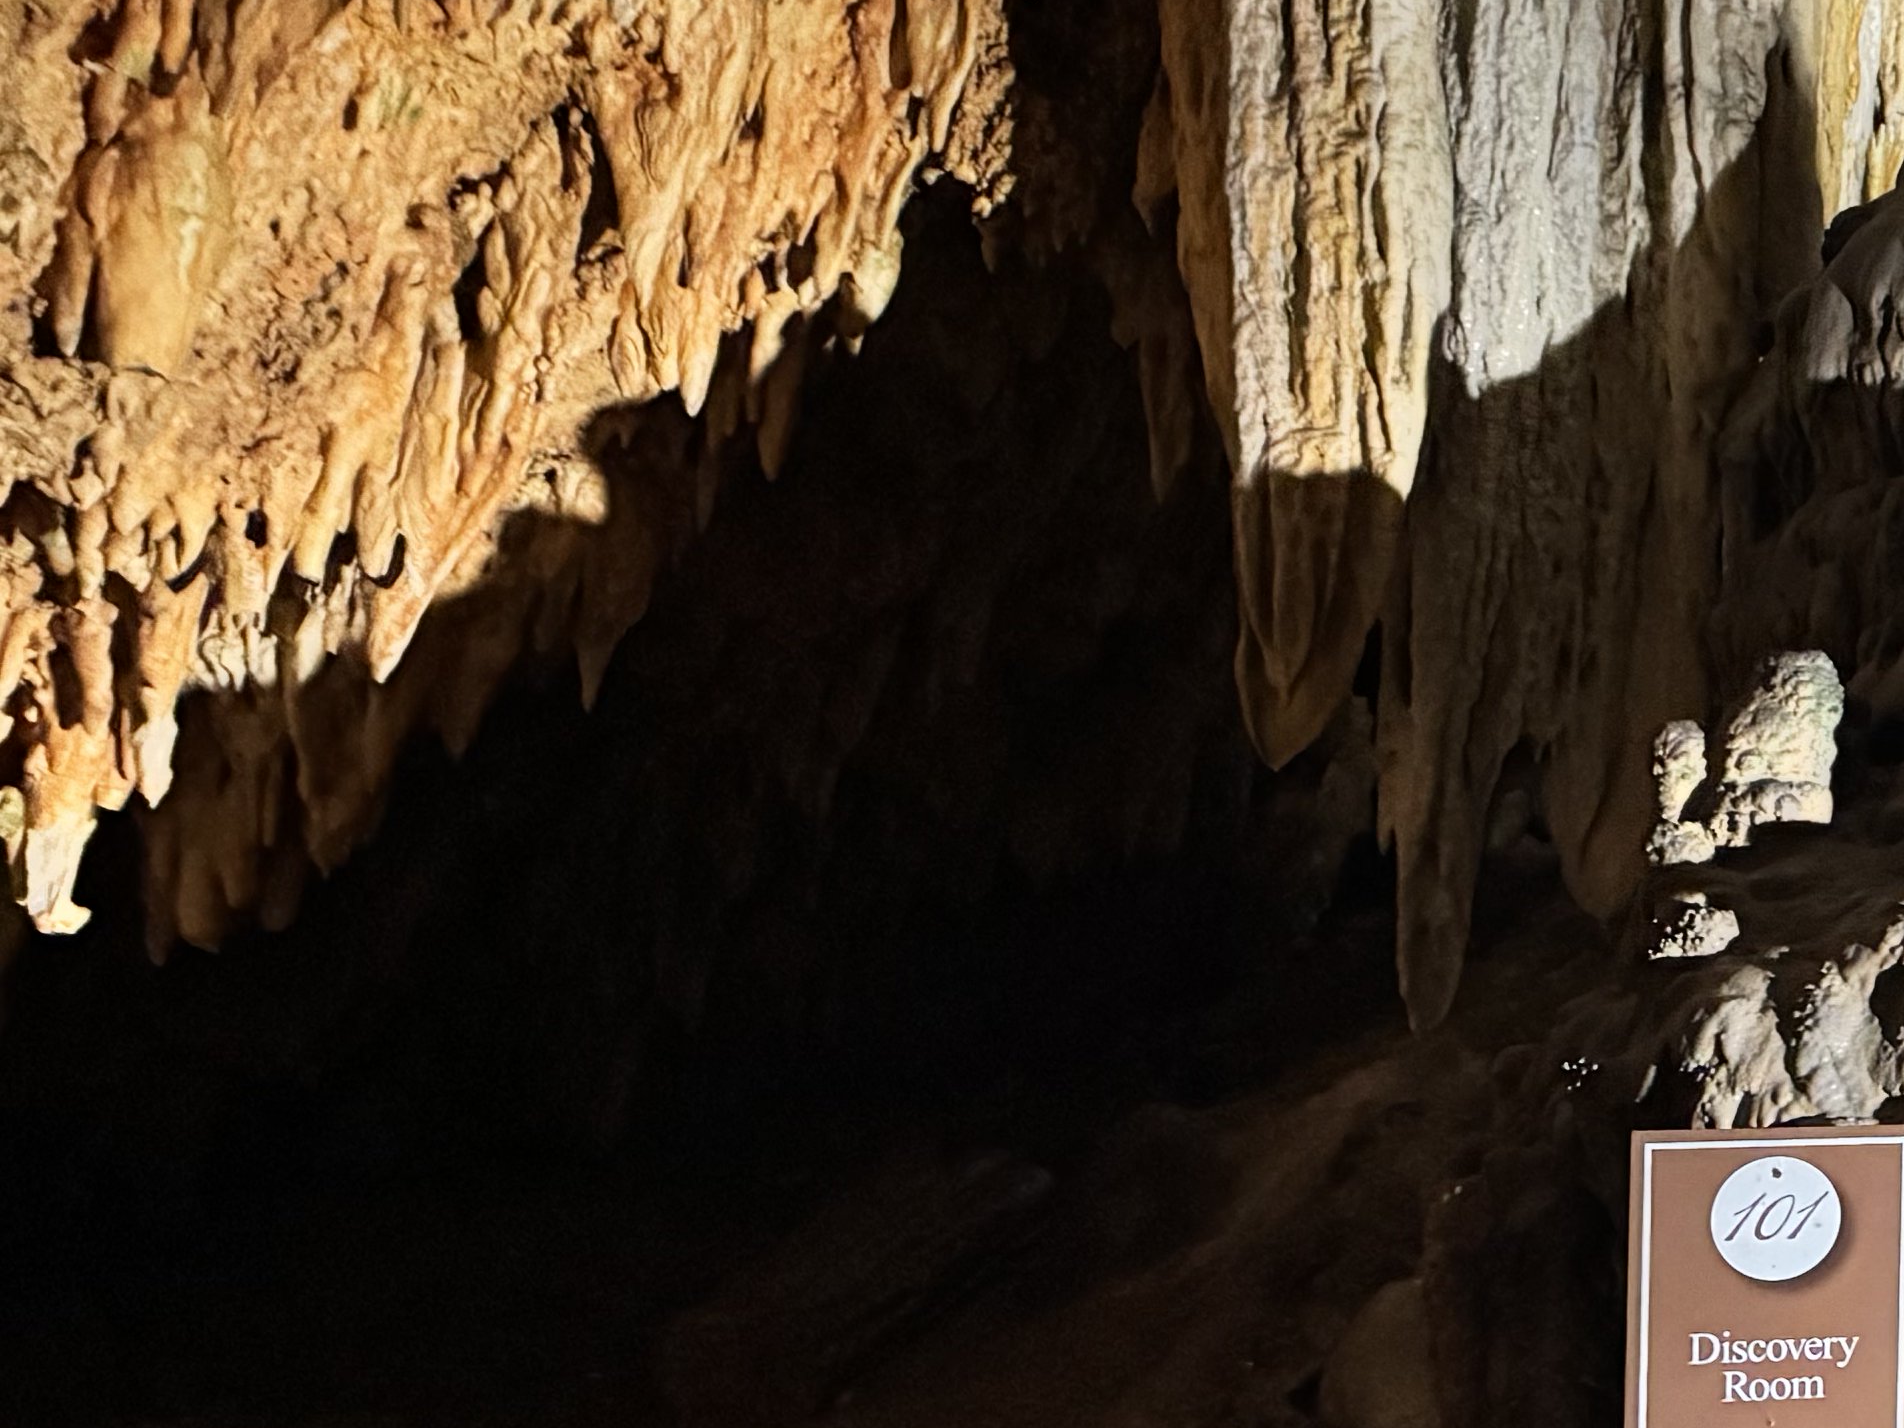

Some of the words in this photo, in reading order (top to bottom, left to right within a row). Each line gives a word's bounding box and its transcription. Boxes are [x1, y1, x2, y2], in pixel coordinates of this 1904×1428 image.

[1724, 1190, 1829, 1242] 101
[1688, 1331, 1859, 1367] Discovery
[1721, 1371, 1825, 1404] Room
